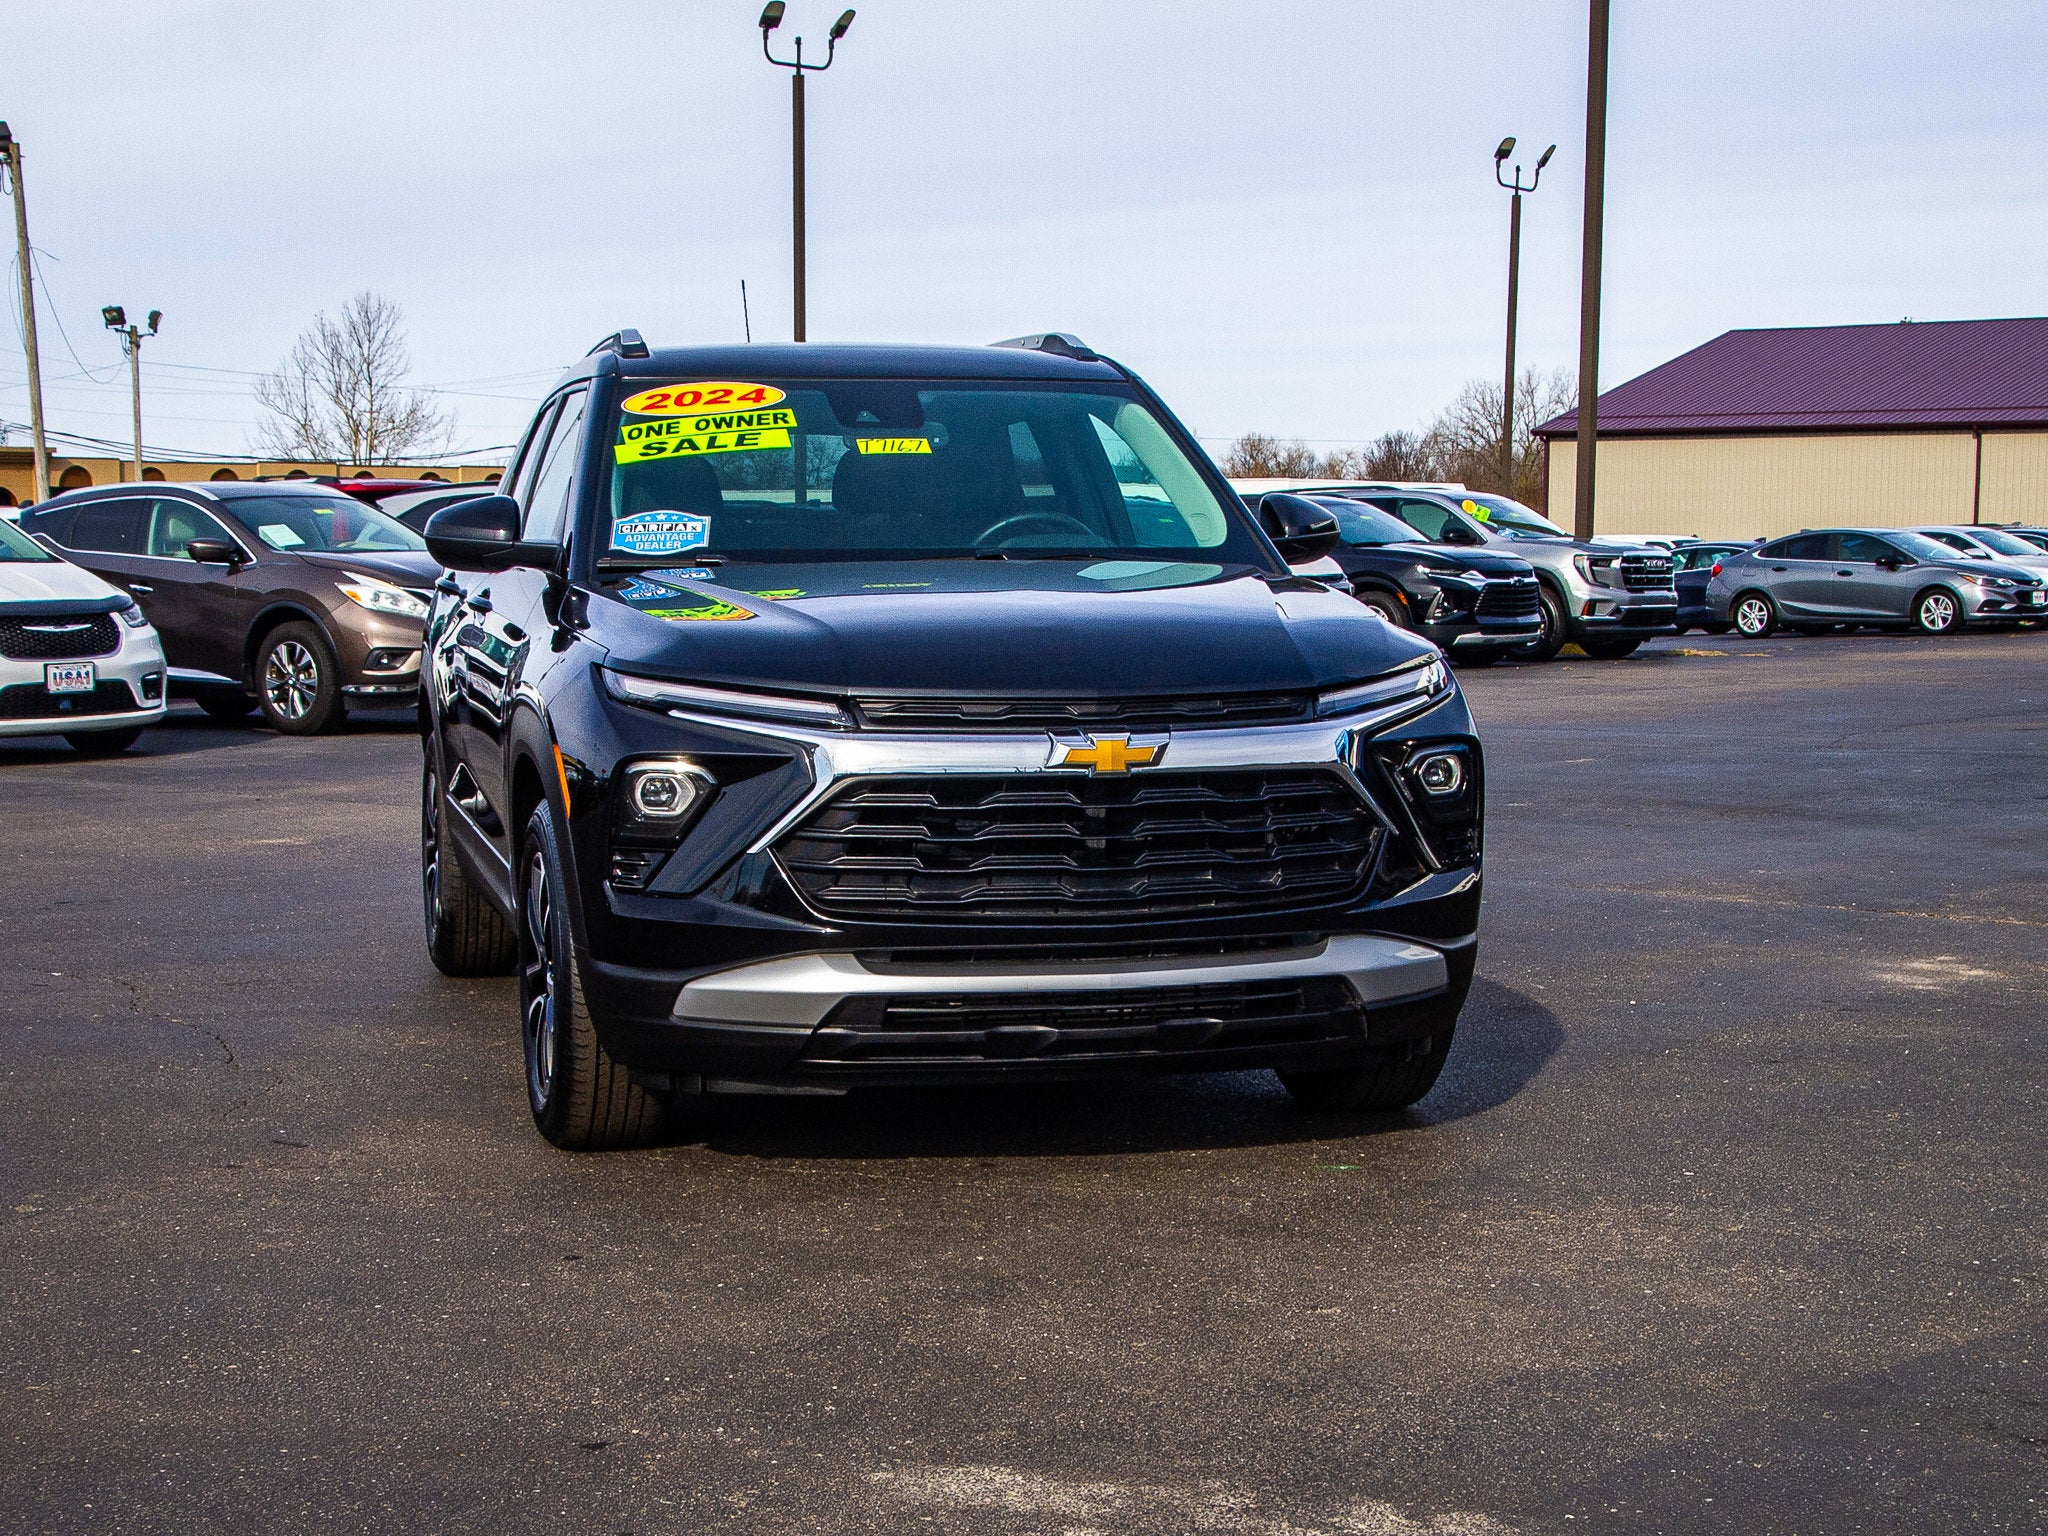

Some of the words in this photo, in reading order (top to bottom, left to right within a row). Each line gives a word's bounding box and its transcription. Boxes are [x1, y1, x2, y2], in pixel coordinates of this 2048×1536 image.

[640, 388, 767, 411] 2024
[627, 421, 681, 441] ONE
[694, 412, 790, 431] OWNER
[638, 432, 762, 457] SALE
[619, 522, 702, 533] CARFAX
[624, 532, 695, 543] ADVANTAGE
[635, 541, 682, 550] DEALER
[52, 670, 91, 686] USA1
